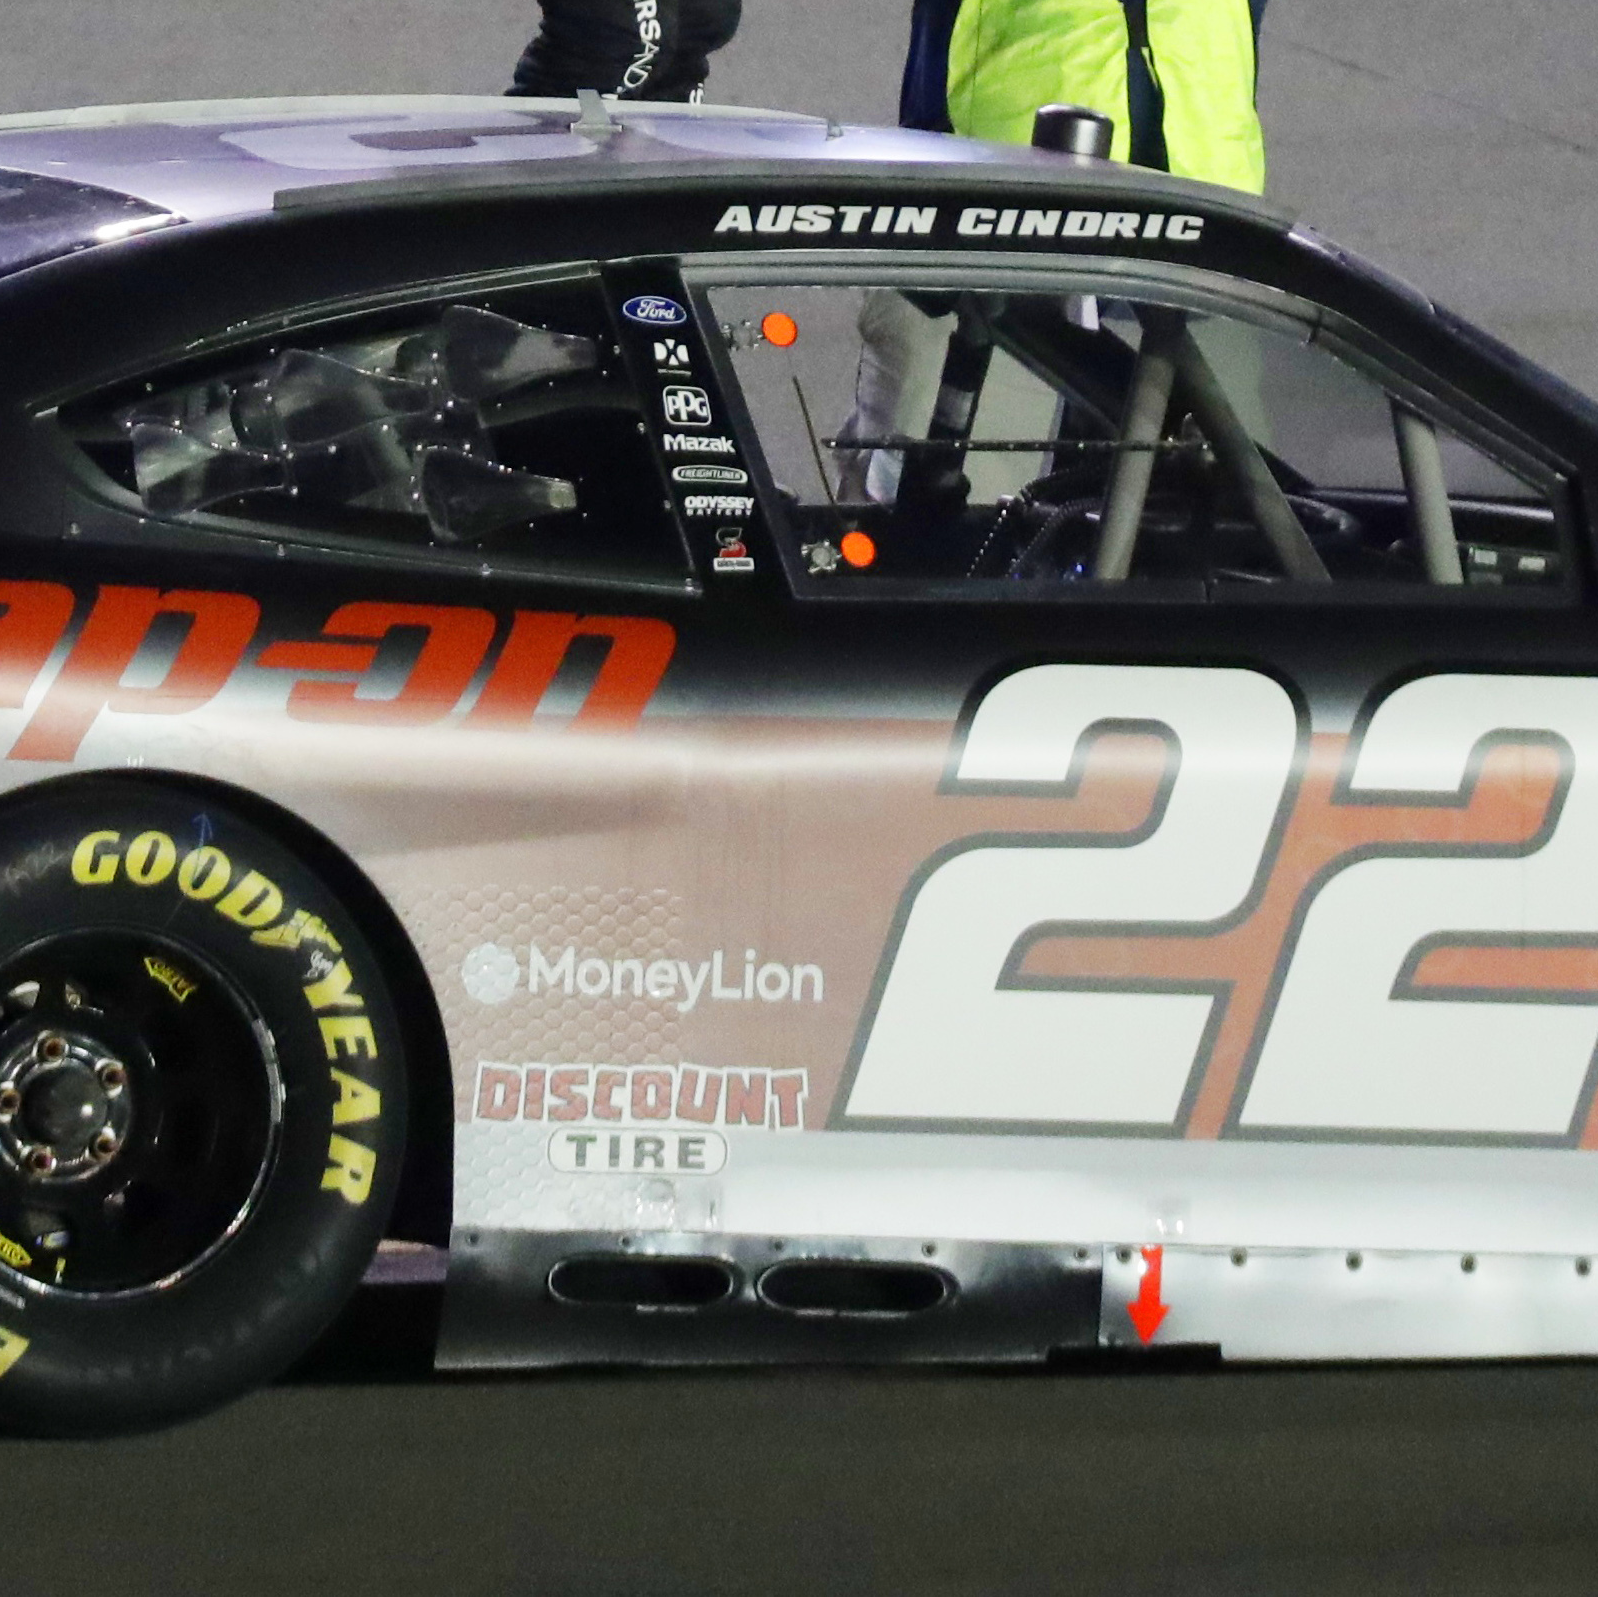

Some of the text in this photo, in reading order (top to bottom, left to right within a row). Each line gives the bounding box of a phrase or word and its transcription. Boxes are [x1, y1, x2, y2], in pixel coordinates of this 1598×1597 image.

[715, 205, 1205, 240] AUSTIN CINDRIC
[636, 298, 677, 321] Ford
[666, 390, 709, 422] PPG
[663, 433, 736, 454] Mazak
[684, 495, 754, 509] ODYSSEY
[686, 508, 753, 517] BATTERY
[527, 944, 825, 1012] MoneyLion
[71, 830, 382, 1205] GOODYEAR
[472, 1061, 808, 1130] DISCOUNT
[565, 1134, 707, 1169] TIRE
